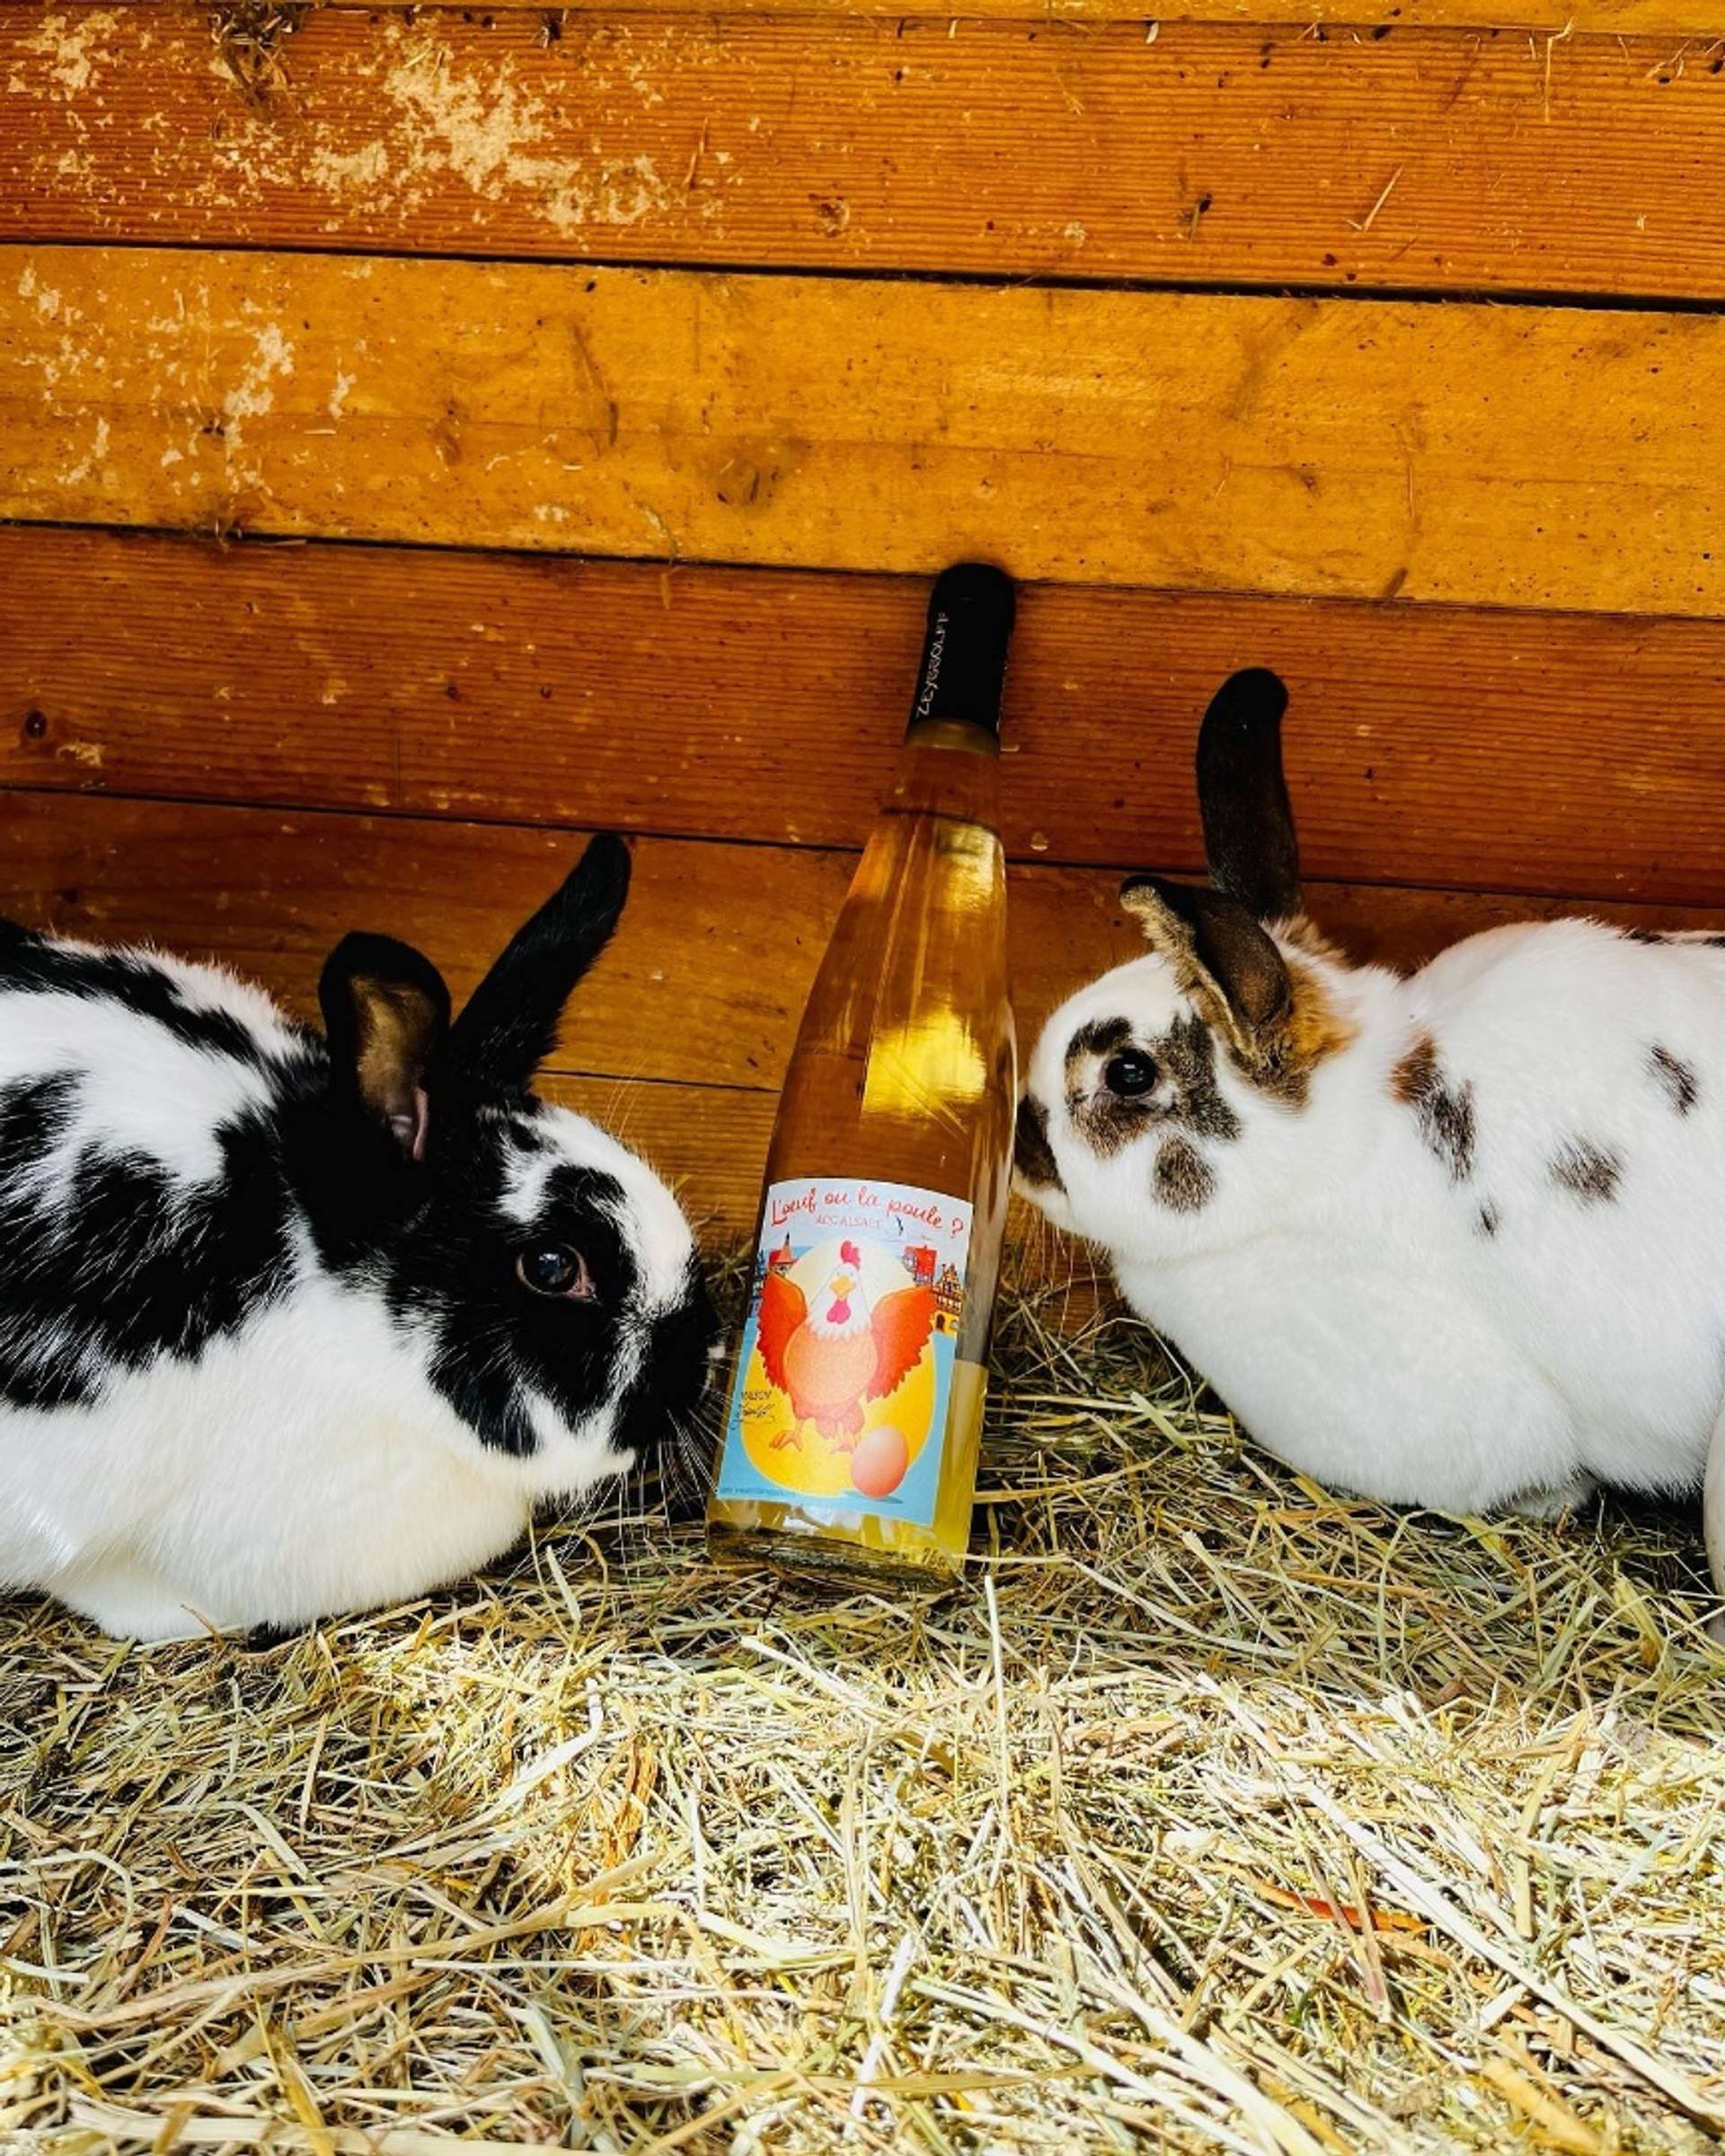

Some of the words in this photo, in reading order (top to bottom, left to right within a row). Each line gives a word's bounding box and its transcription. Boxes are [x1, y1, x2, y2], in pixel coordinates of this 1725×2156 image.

[916, 611, 950, 720] ZEYSSOLFF
[824, 1192, 848, 1205] ou
[858, 1185, 880, 1206] la
[885, 1198, 943, 1228] poule
[951, 1216, 964, 1239] ?
